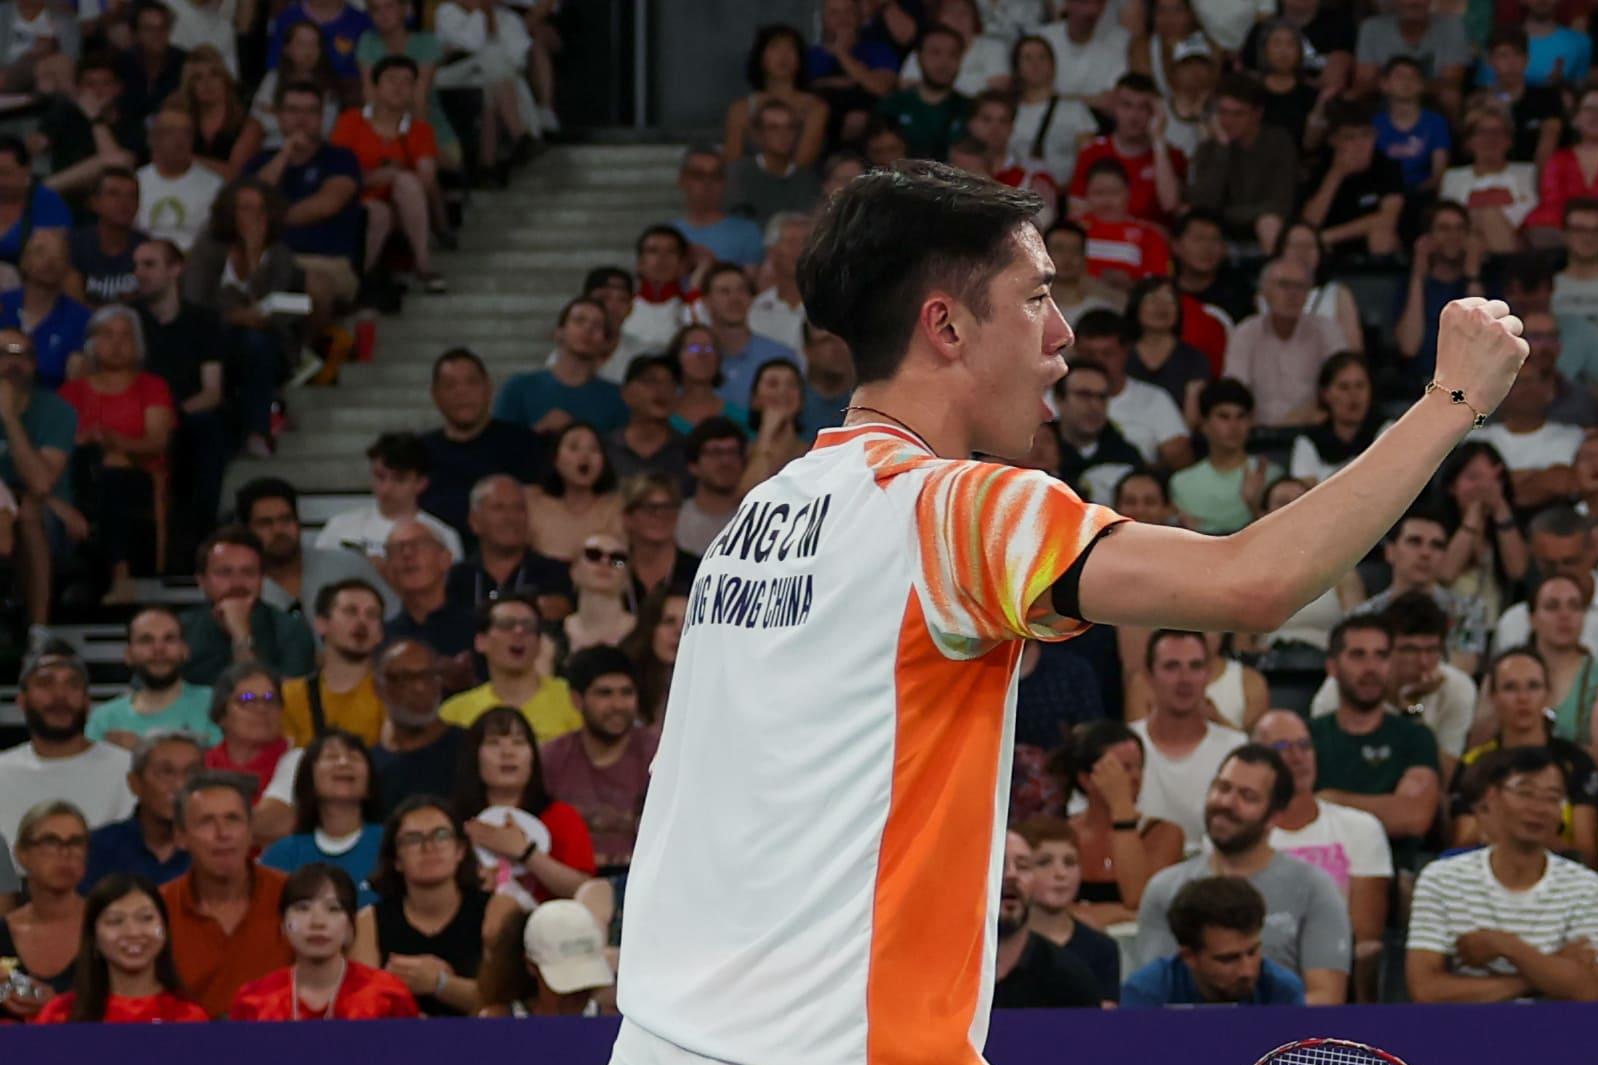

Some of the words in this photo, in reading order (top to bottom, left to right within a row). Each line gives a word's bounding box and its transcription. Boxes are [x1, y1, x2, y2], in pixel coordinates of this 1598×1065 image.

[705, 501, 790, 563] ANG
[711, 573, 766, 629] KONG
[763, 574, 813, 629] CHINA
